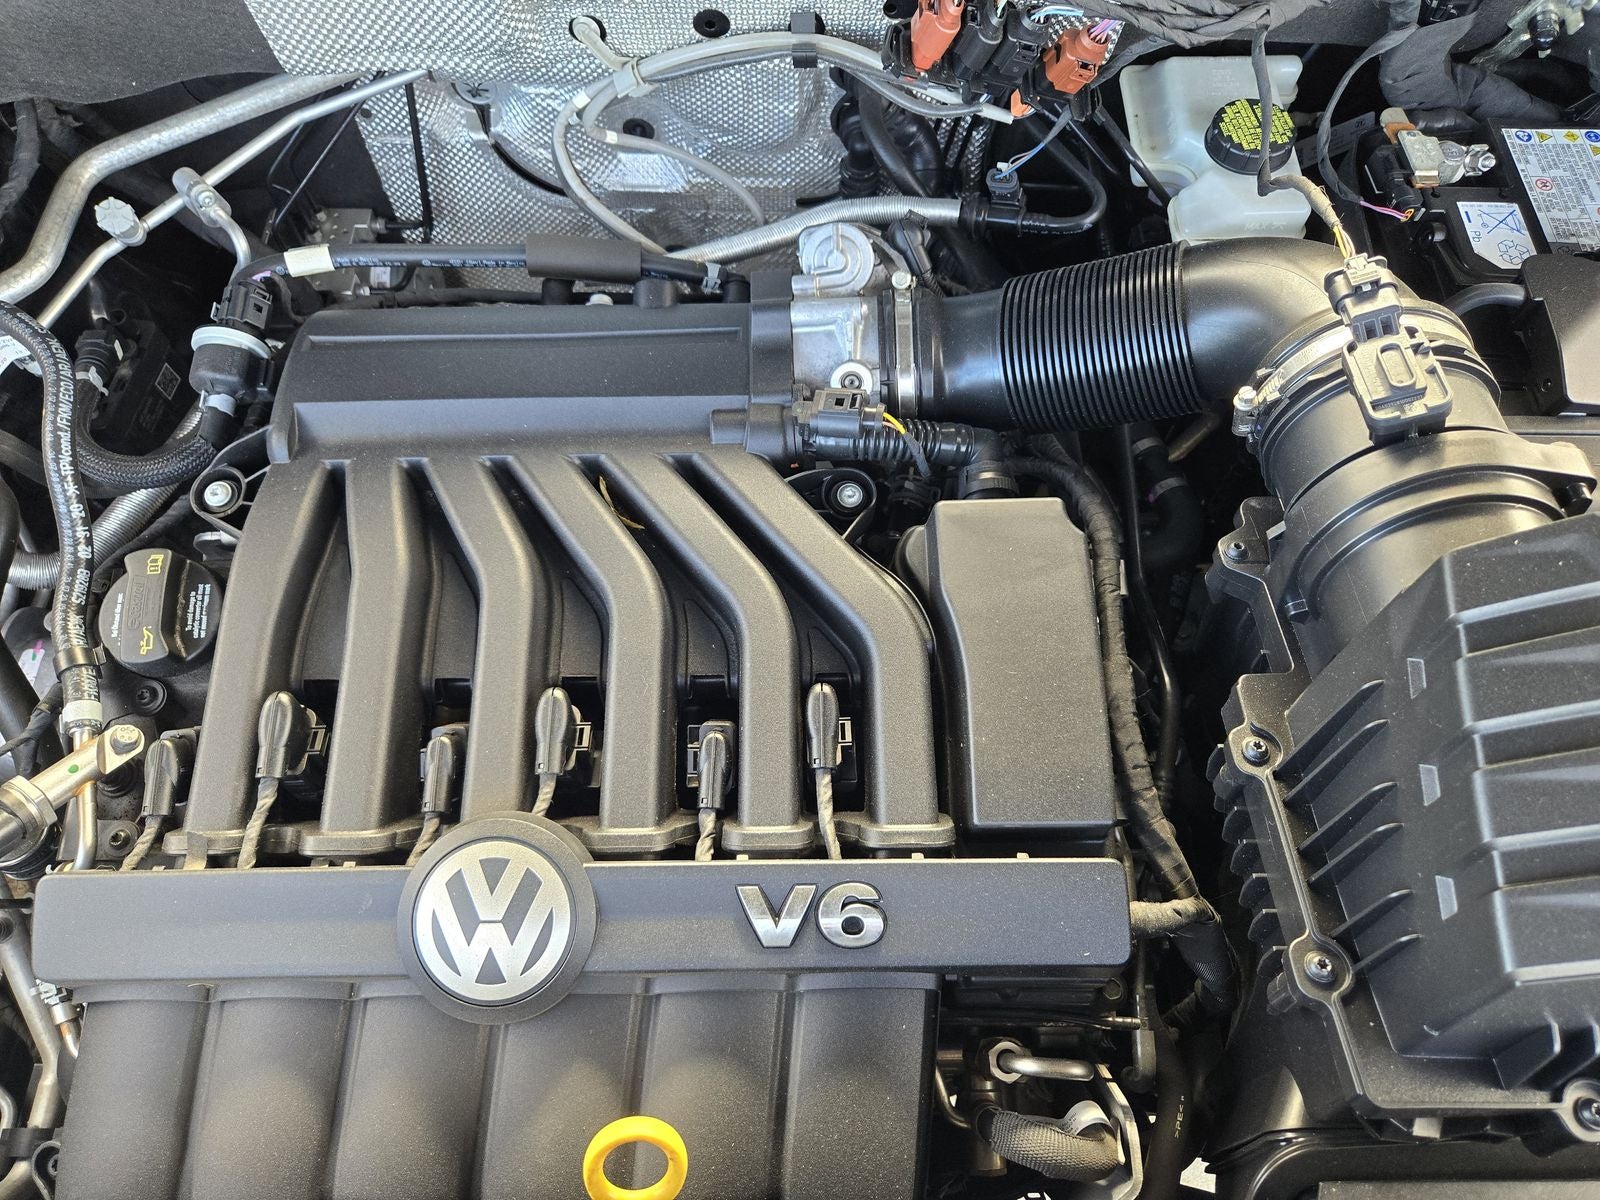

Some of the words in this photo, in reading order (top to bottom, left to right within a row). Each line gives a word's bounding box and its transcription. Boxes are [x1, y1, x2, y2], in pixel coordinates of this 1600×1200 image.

[1470, 230, 1482, 243] Pb
[70, 503, 86, 518] 20
[76, 526, 90, 538] 31
[78, 545, 92, 559] 02
[413, 839, 574, 1002] VW
[735, 880, 888, 949] V6
